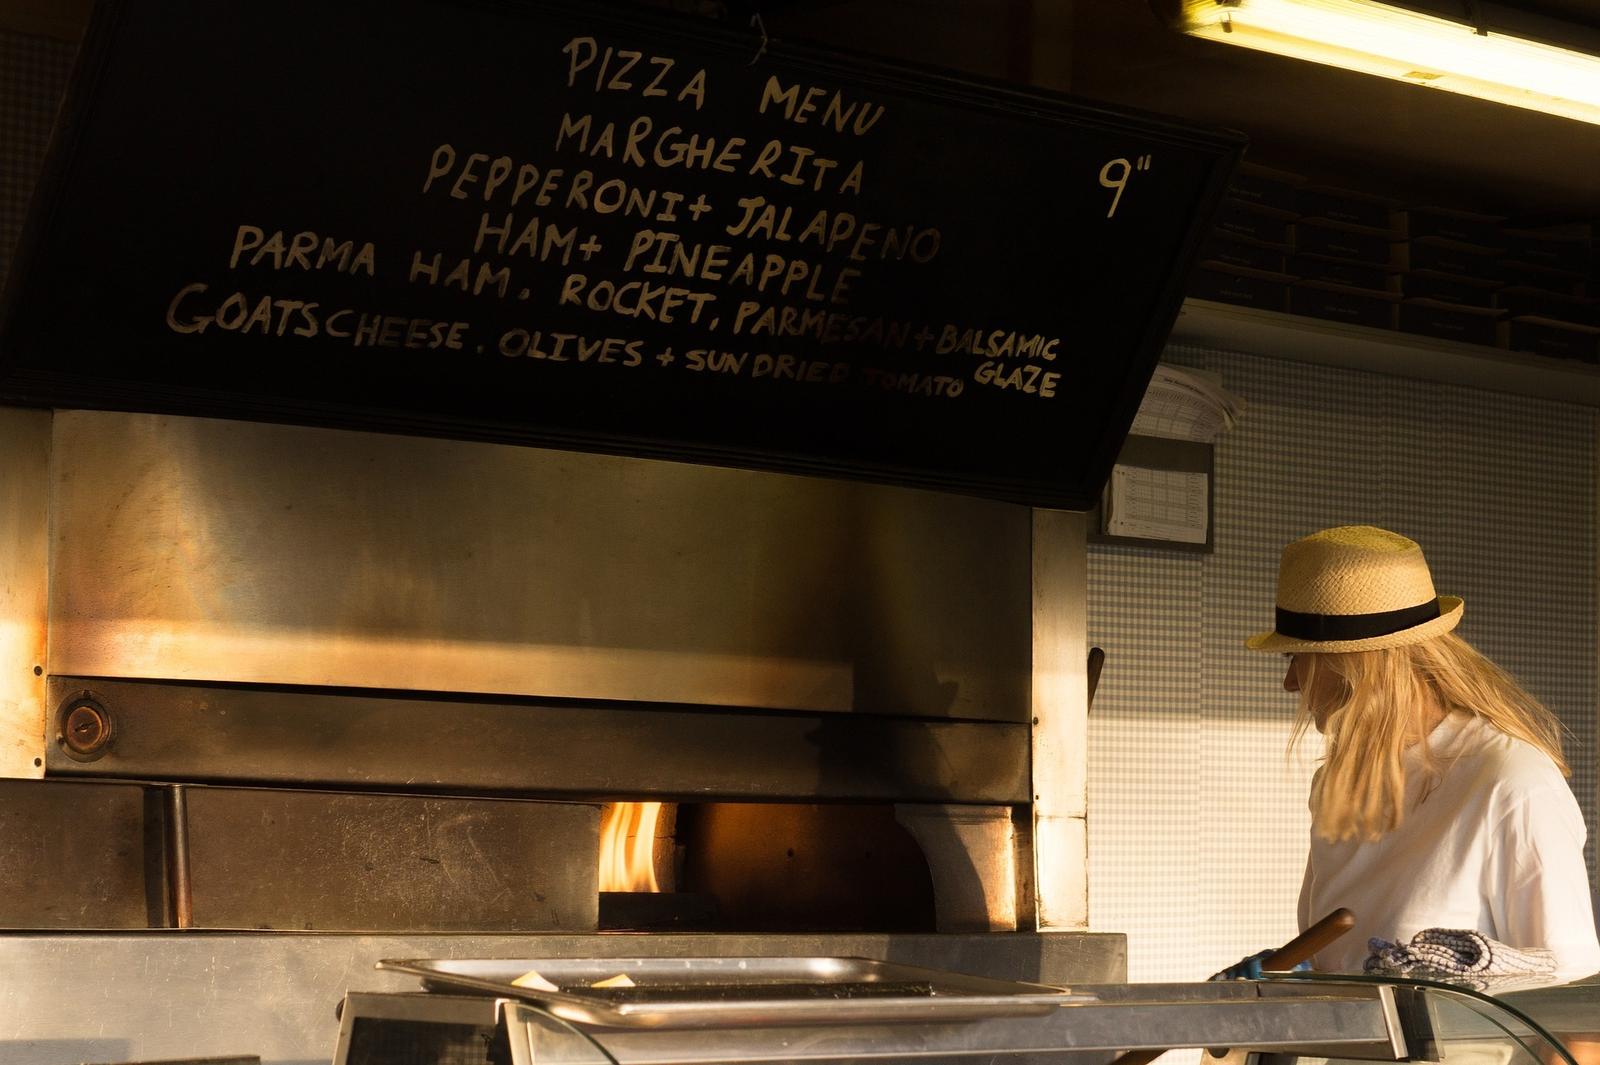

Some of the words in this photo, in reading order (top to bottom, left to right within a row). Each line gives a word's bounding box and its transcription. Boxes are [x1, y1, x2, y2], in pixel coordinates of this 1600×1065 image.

[561, 35, 706, 110] PIZZA
[759, 74, 884, 136] MENU
[555, 112, 864, 194] MARGHERITA
[229, 225, 375, 274] PARMA
[726, 197, 941, 263] JALAPENO
[624, 229, 861, 304] PINEAPPLE
[500, 329, 643, 366] OLIVES
[655, 346, 676, 368] +
[864, 365, 964, 397] TOMATO
[974, 361, 1062, 397] GLAZE
